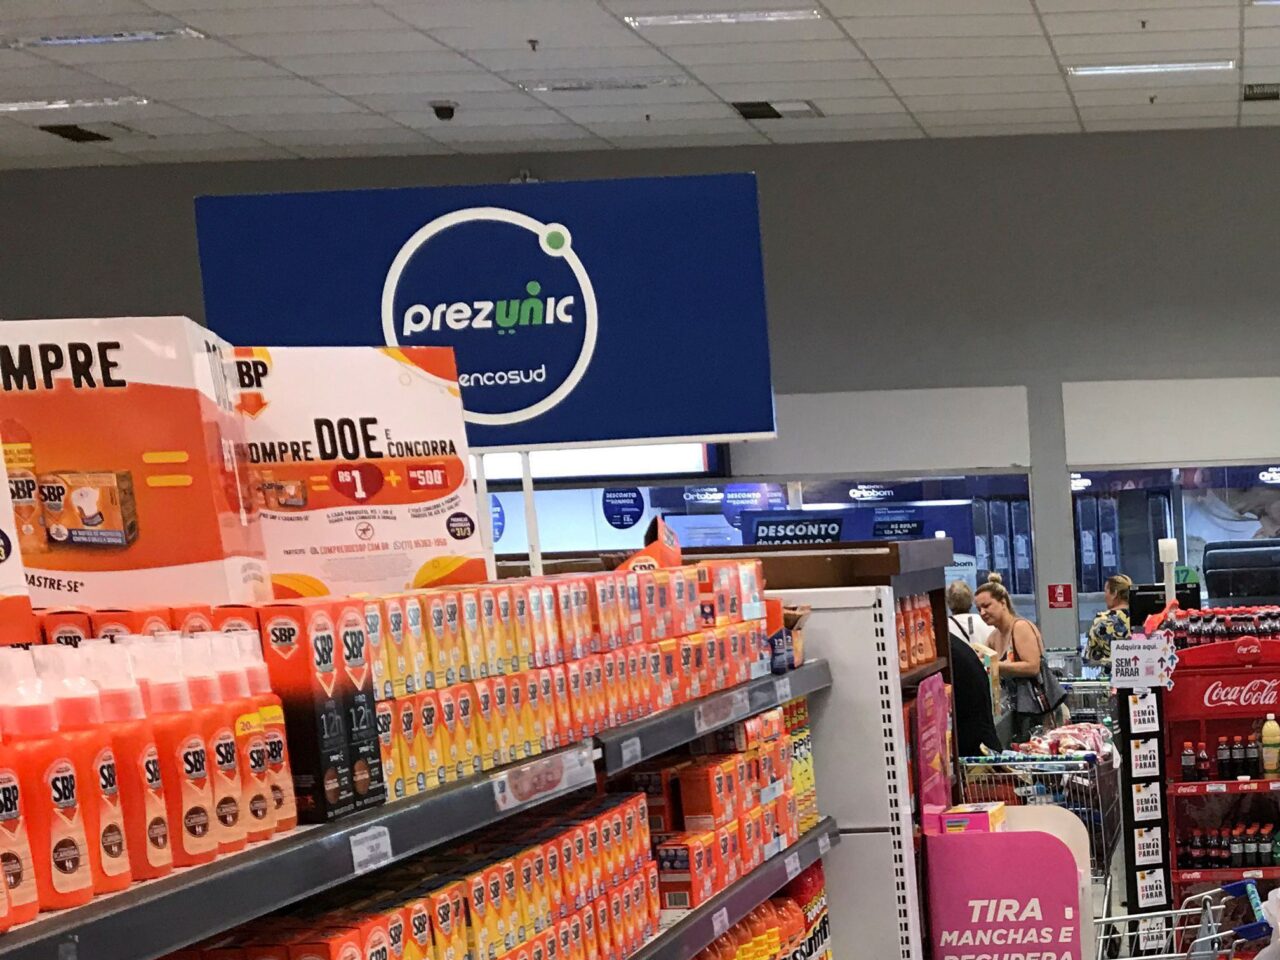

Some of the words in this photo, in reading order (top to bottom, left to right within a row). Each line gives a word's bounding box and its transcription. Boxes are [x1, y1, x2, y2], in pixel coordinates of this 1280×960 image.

[236, 361, 268, 387] BP
[459, 364, 546, 387] encosud
[314, 418, 383, 461] DOE
[384, 429, 391, 440] E
[388, 440, 456, 458] CONCORRA
[758, 523, 839, 537] DESCONTO
[271, 627, 296, 643] SBP
[343, 626, 365, 660] SBP
[1116, 643, 1140, 652] Adquira
[313, 634, 333, 666] SBP
[1115, 668, 1139, 677] PARAR
[1116, 658, 1131, 668] SEM
[1203, 679, 1280, 707] Coca-Cola
[52, 776, 75, 802] SBP
[413, 909, 427, 937] SBP
[968, 898, 1042, 923] TIRA
[940, 927, 1052, 947] MANCHAS
[1059, 926, 1074, 943] E
